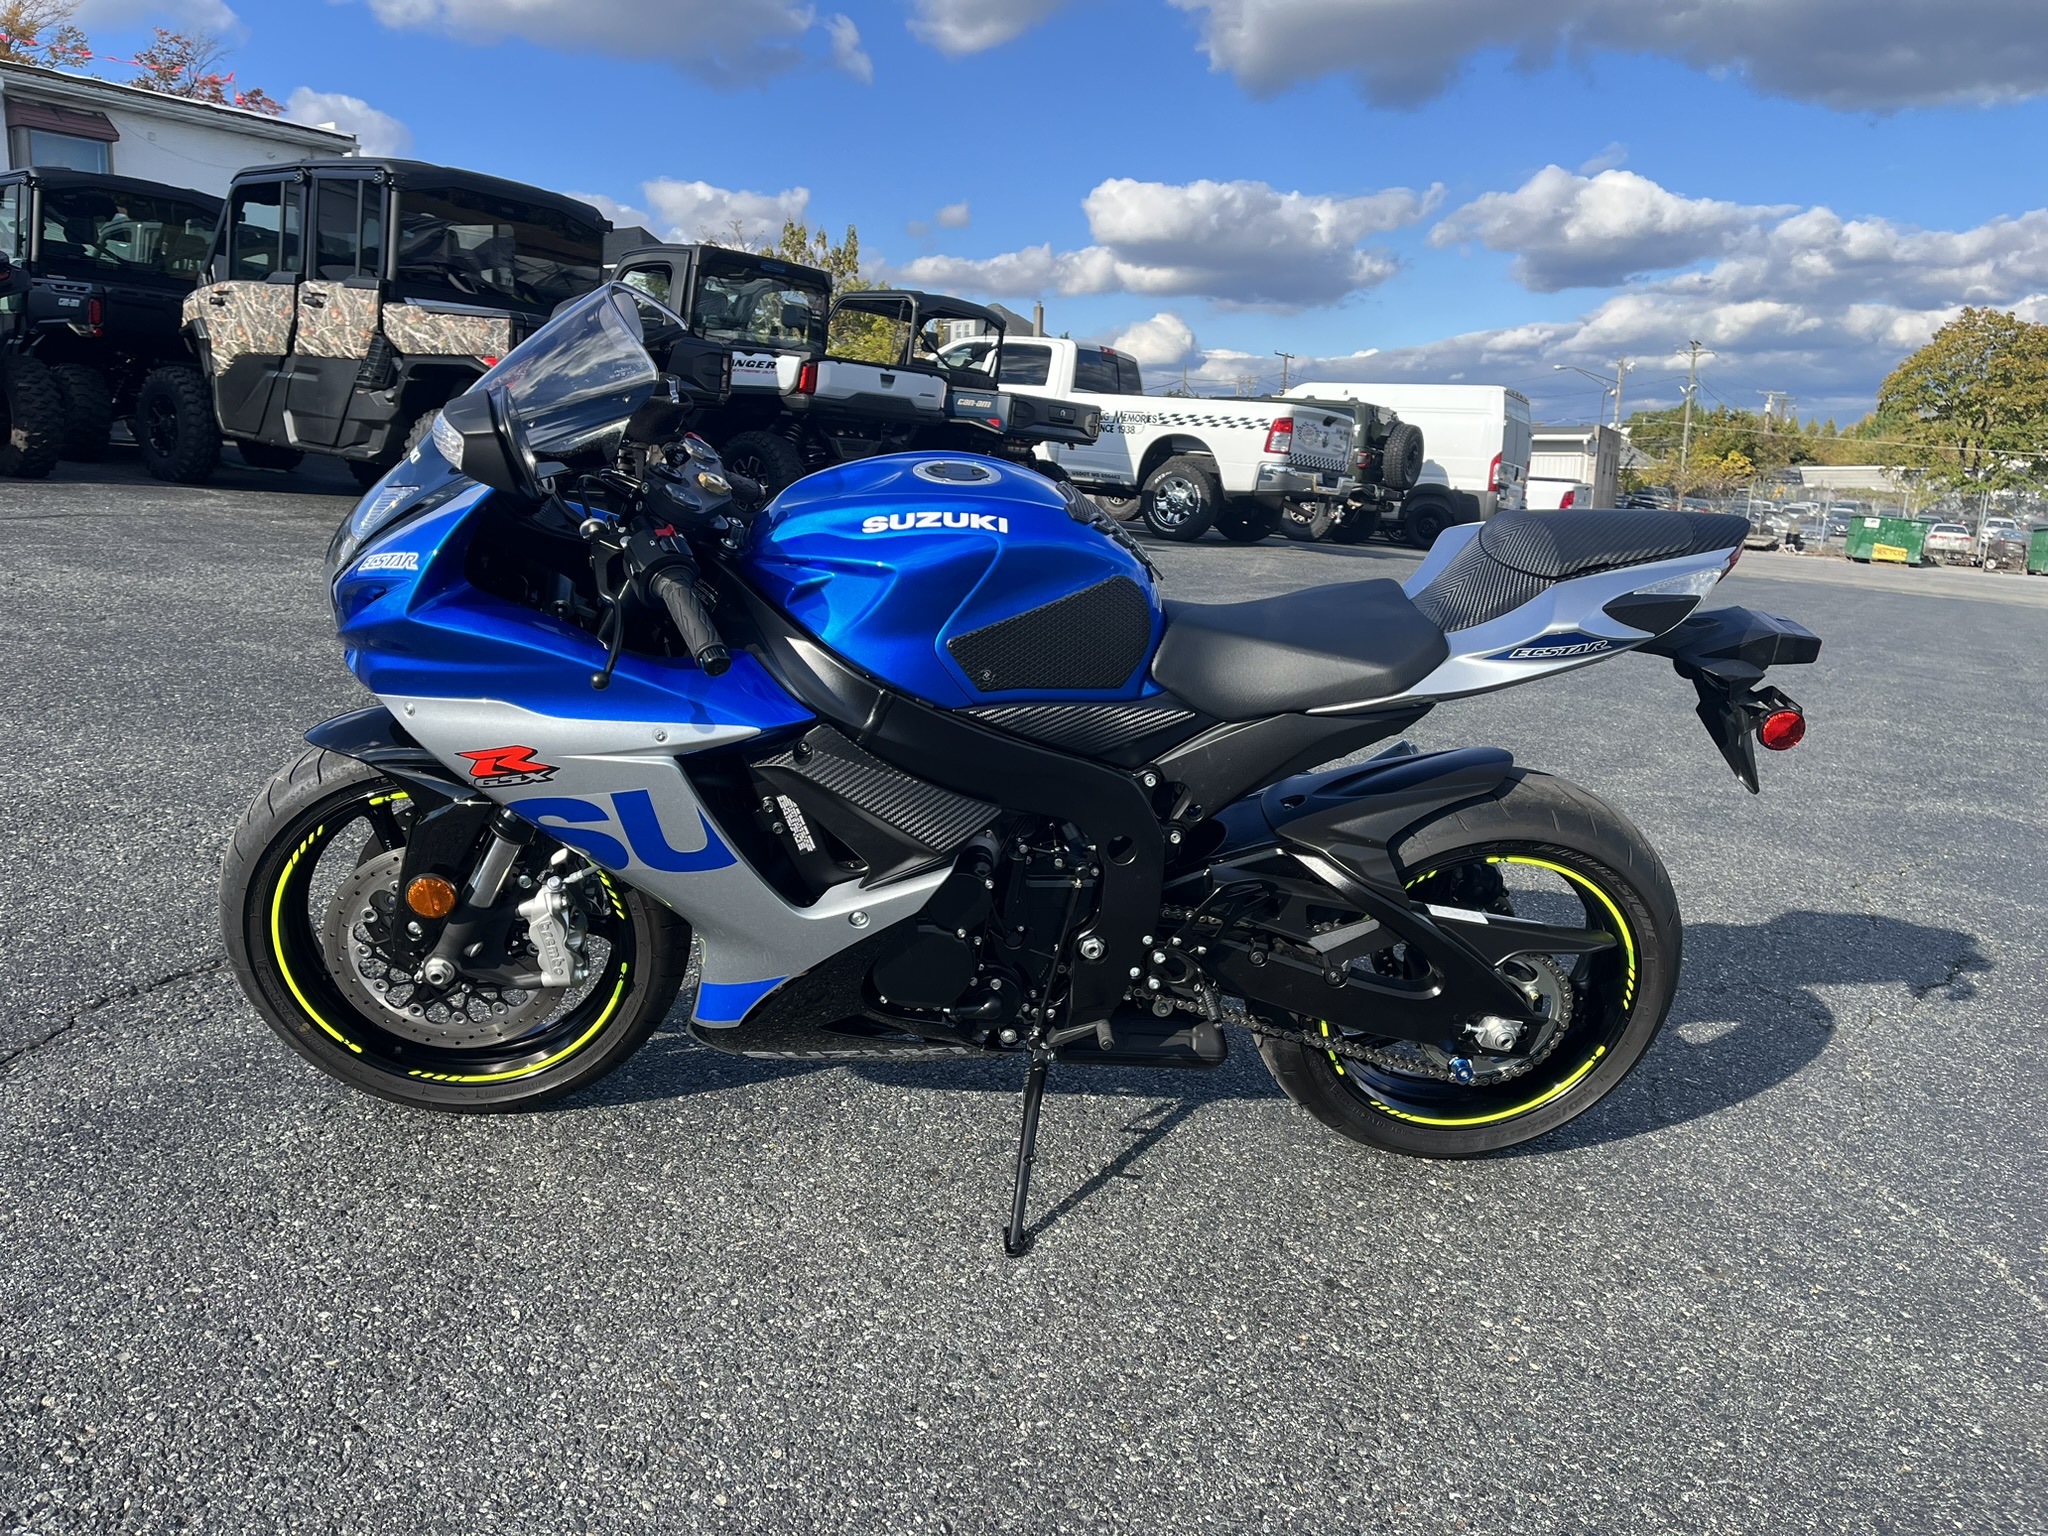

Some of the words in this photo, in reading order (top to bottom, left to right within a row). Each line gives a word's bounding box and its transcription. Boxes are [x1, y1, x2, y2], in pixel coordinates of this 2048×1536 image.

[1118, 425, 1136, 434] 1938
[862, 512, 1008, 534] SUZUKI
[359, 553, 419, 571] ECSTAR
[1509, 640, 1612, 658] ECSTAR
[473, 771, 555, 788] GSX
[504, 789, 738, 873] SU
[537, 920, 566, 976] brembo
